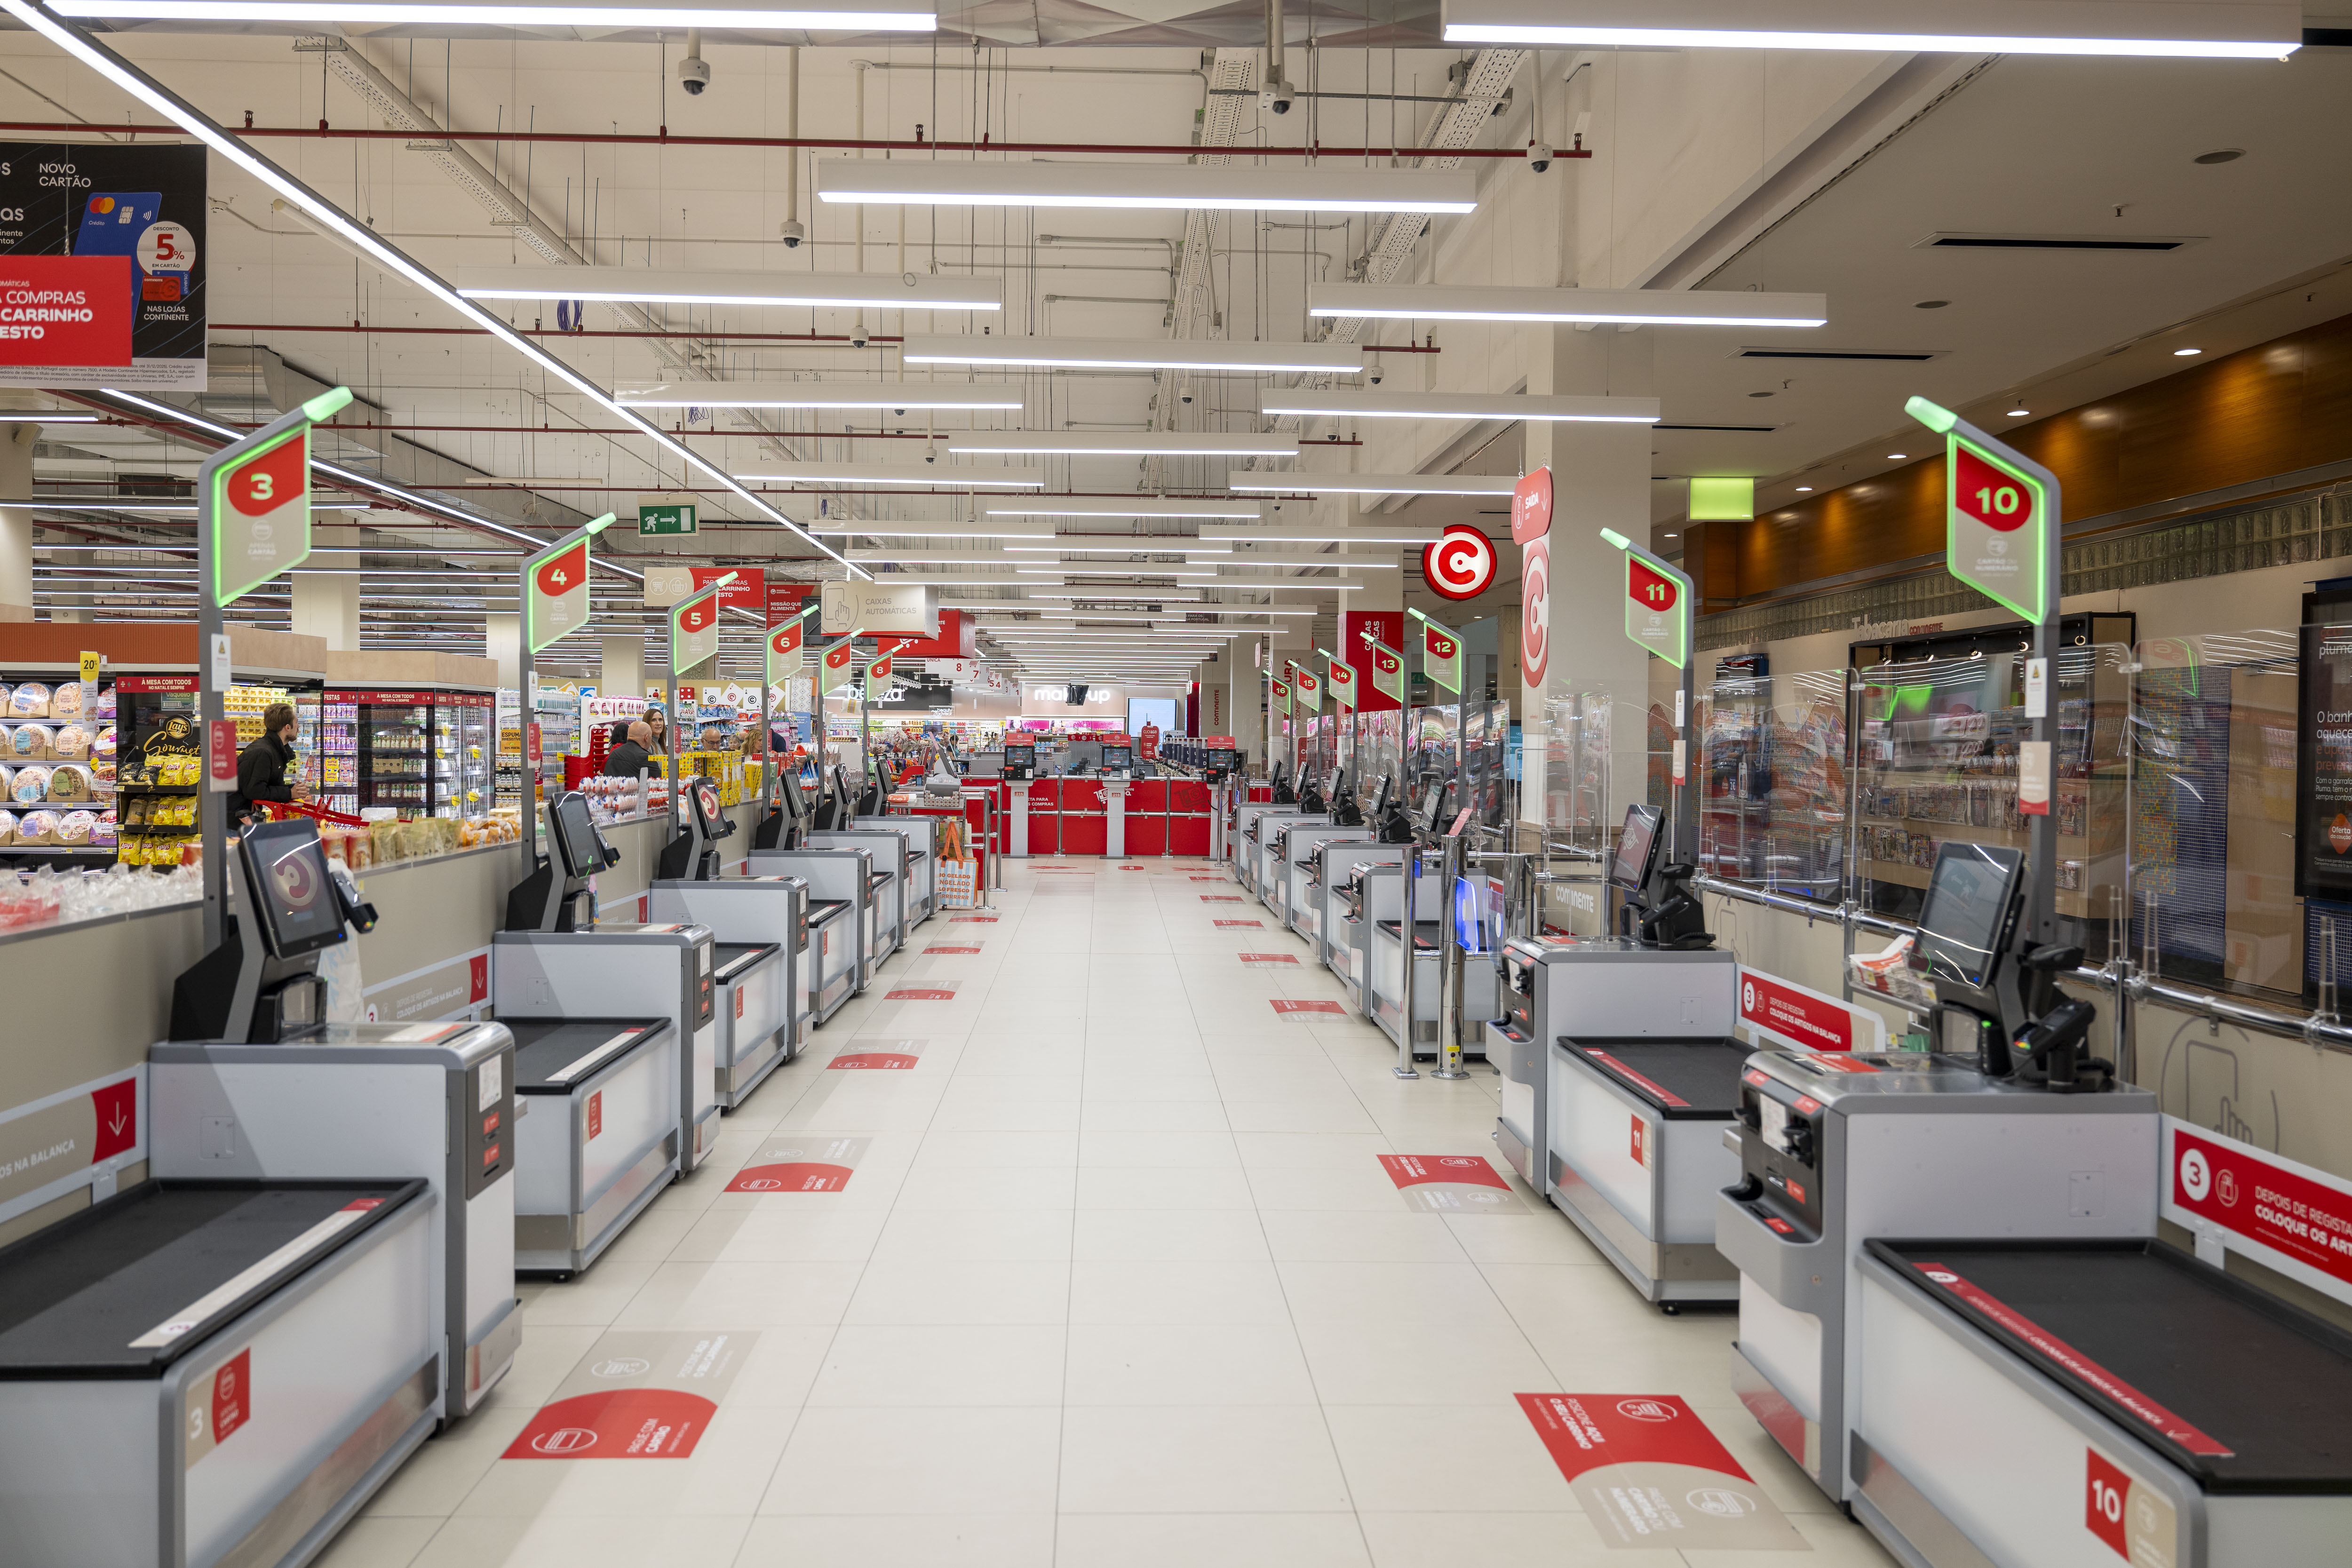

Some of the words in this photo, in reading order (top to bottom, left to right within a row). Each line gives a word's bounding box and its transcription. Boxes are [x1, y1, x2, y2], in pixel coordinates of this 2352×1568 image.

[40, 163, 76, 174] NOVO
[39, 175, 91, 187] CARTÃO
[156, 234, 184, 260] 5%
[6, 290, 86, 304] COMPRAS
[0, 308, 93, 322] CARRINHO
[250, 473, 273, 500] 3
[1525, 491, 1539, 509] SAÍDA
[1976, 486, 2019, 515] 10
[551, 569, 567, 585] 4
[1645, 583, 1665, 601] 11
[865, 605, 917, 615] AUTOMÁTICAS
[690, 613, 701, 625] 5
[1851, 614, 1909, 641] Tabacaria
[1909, 622, 1943, 635] CONTINENTE
[780, 637, 790, 648] 6
[1434, 642, 1451, 653] 12
[833, 654, 841, 663] 7
[1382, 660, 1395, 669] 13
[956, 663, 962, 672] 8
[2317, 711, 2325, 723] O
[1556, 885, 1594, 913] CONTINENTE
[1746, 988, 1751, 1004] 3
[14, 1157, 29, 1172] NA
[31, 1139, 75, 1168] BALANÇA
[2188, 1161, 2201, 1187] 3
[2254, 1185, 2292, 1212] DEPOIS
[2292, 1201, 2307, 1218] DE
[2254, 1204, 2308, 1238] COLOQUE
[2310, 1228, 2328, 1246] OS
[190, 1406, 204, 1441] 3
[2091, 1479, 2122, 1523] 10
